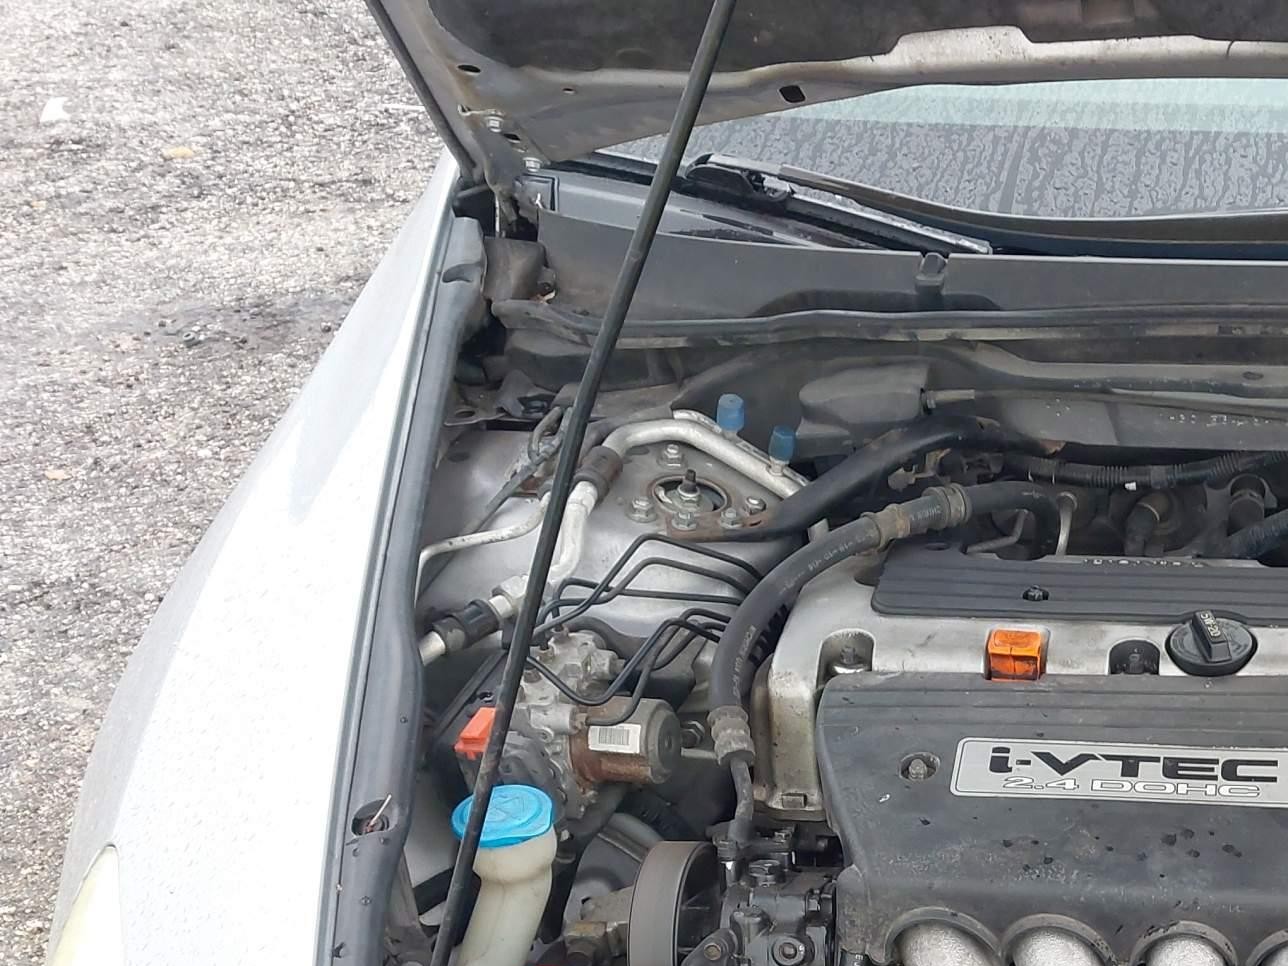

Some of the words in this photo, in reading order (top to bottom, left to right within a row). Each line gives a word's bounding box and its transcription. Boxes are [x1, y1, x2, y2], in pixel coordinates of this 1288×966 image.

[1200, 612, 1221, 637] 5W-20
[988, 746, 1279, 783] i-VTEC
[1002, 774, 1080, 792] 2.4
[1091, 777, 1261, 798] DOHC
